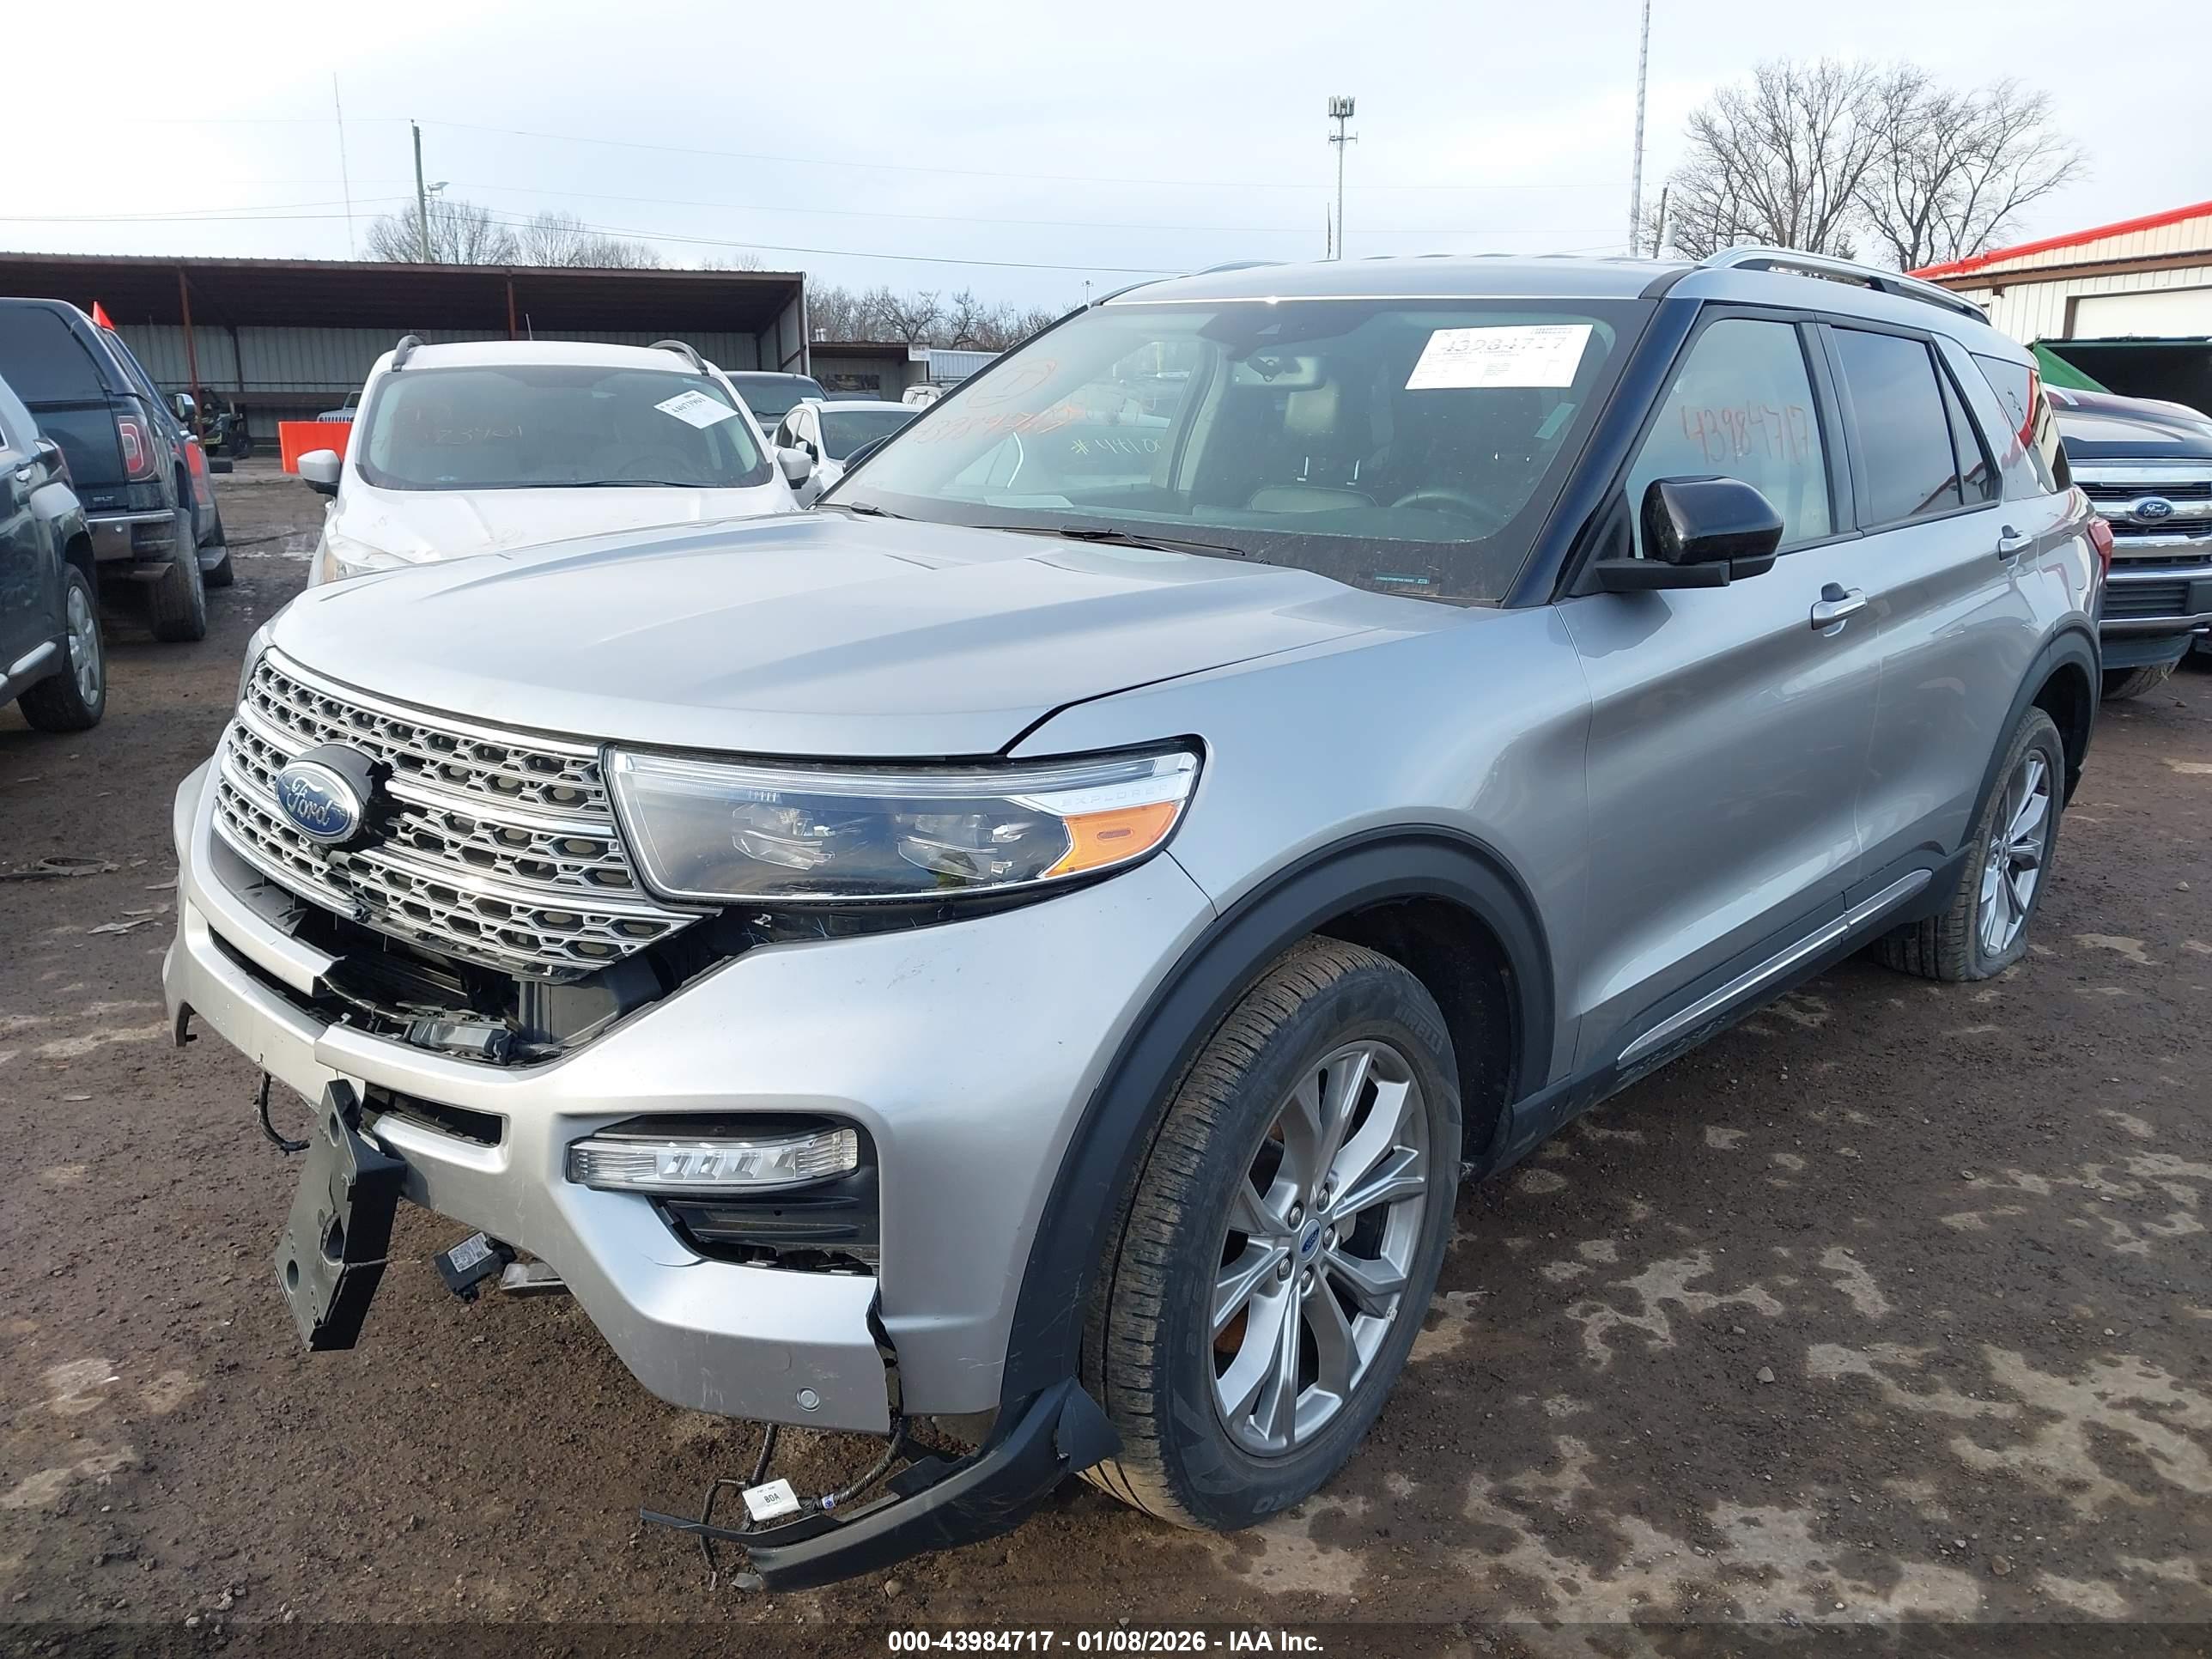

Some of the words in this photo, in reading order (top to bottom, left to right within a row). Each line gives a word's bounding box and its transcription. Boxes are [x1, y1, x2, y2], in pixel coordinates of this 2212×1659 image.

[1680, 400, 1808, 465] 43984717
[2143, 503, 2167, 517] Ford
[287, 776, 332, 827] Ford
[1061, 784, 1168, 806] EXPLORER
